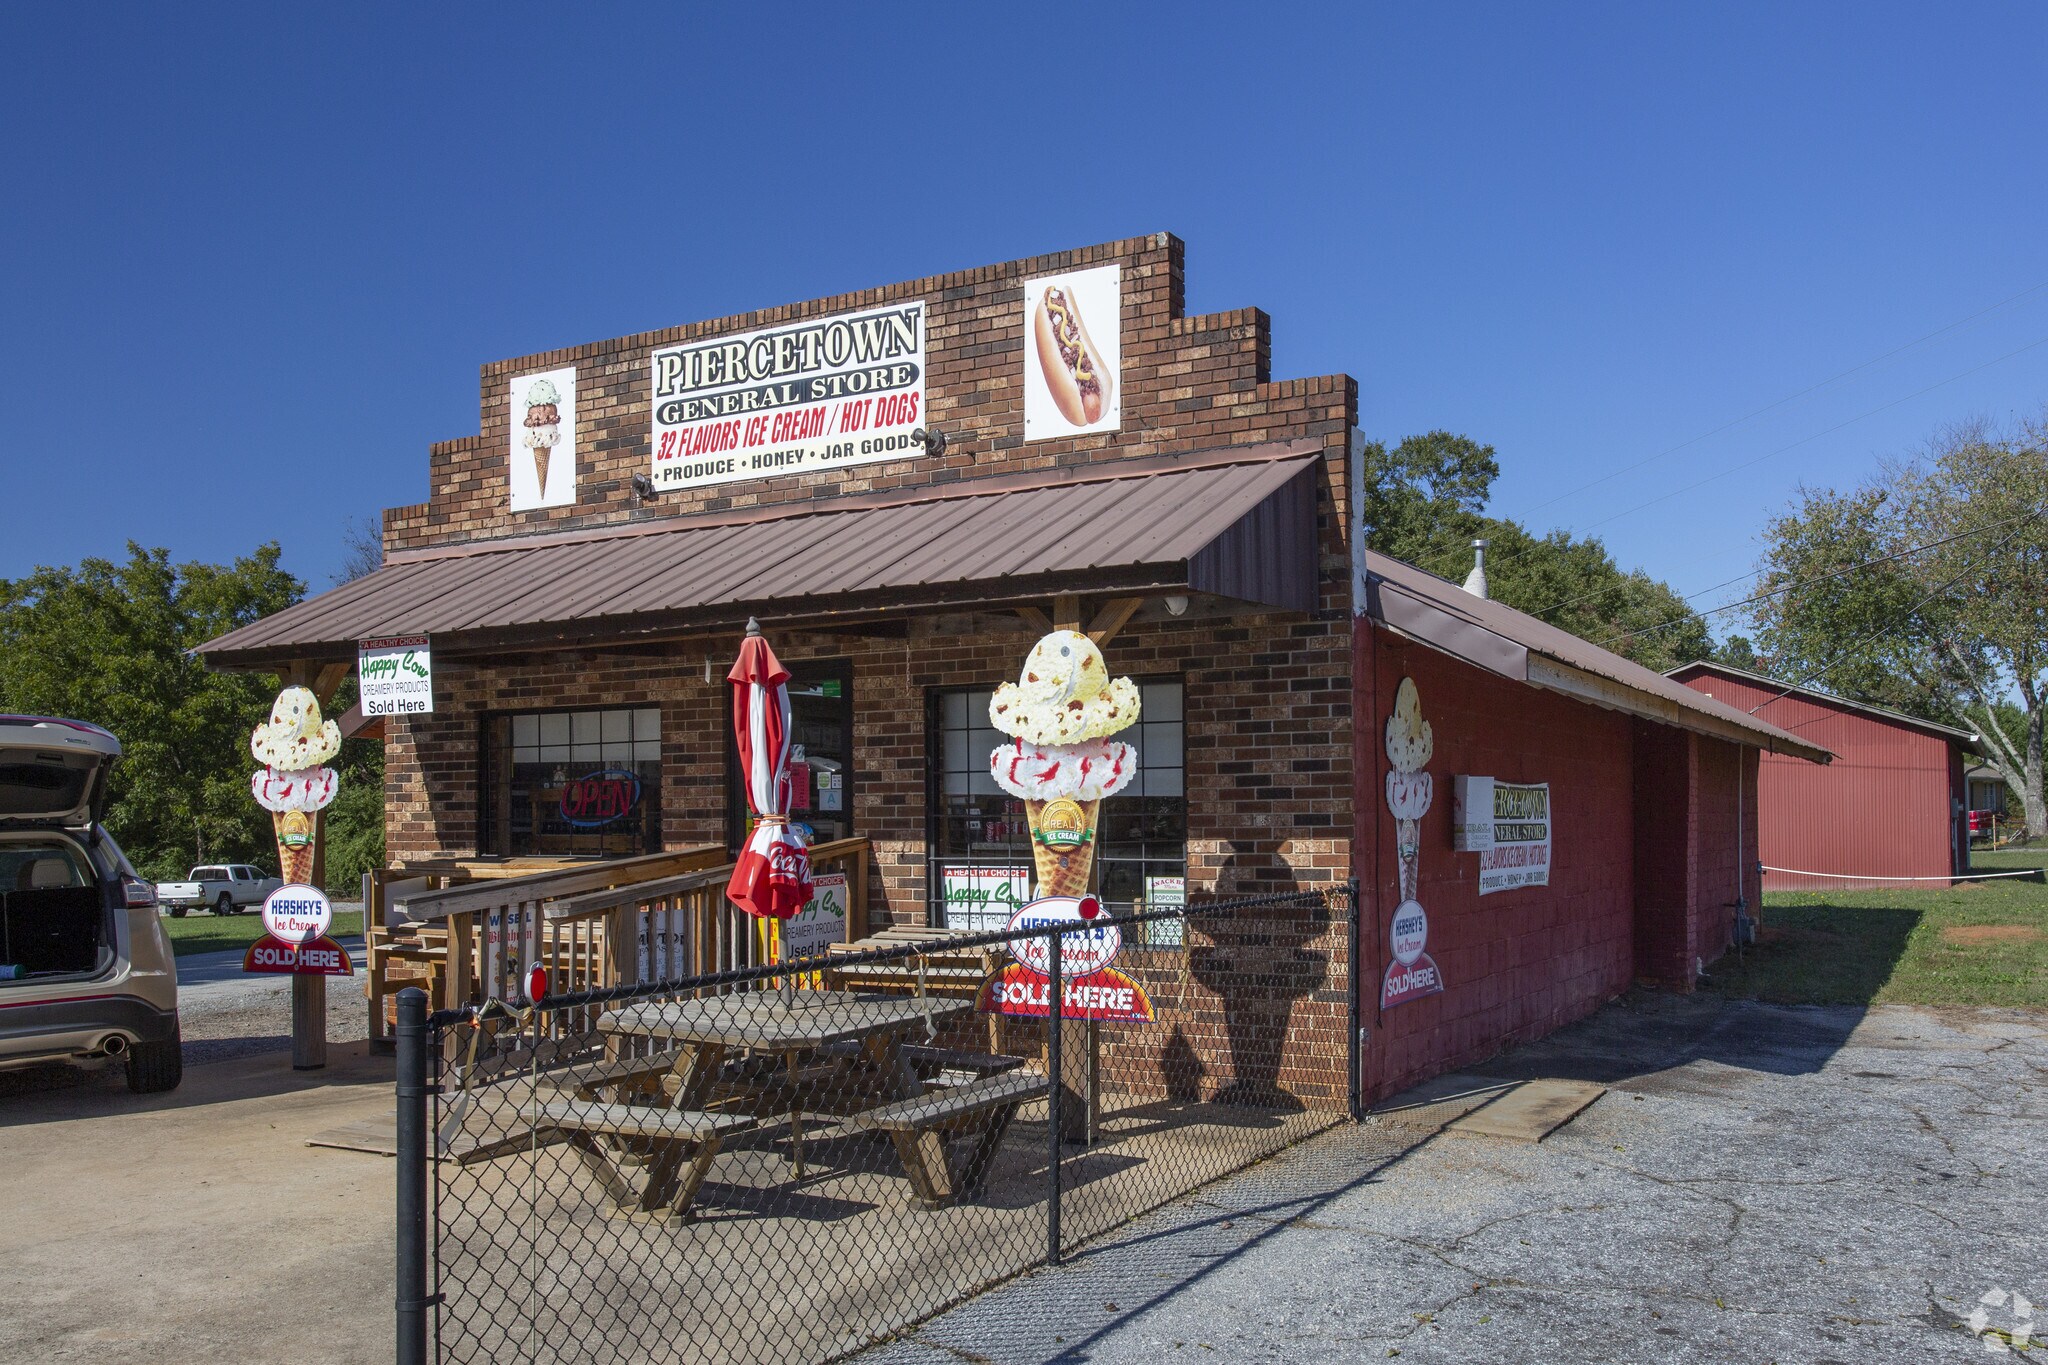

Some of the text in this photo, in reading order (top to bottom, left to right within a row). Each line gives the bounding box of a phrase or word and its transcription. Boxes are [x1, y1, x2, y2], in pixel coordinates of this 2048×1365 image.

[656, 306, 922, 397] PIERCETOWN
[661, 364, 912, 423] GENERAL STORE
[657, 431, 677, 461] 32
[680, 419, 740, 457] FLAVORS
[742, 415, 769, 448] ICE
[771, 406, 827, 445] CREAM
[840, 398, 872, 432] HOT
[873, 391, 919, 428] DOGS
[664, 434, 920, 482] PRODUCE HONEY JAR GOODS
[369, 639, 399, 648] HEALTHY
[361, 649, 429, 680] Happy Cow
[363, 680, 429, 696] CREAMERY PRODUCTS
[368, 698, 425, 714] Sold Here
[561, 780, 633, 816] OPEN
[1493, 787, 1547, 820] ERCETOWN
[1050, 819, 1075, 829] REAL
[1494, 824, 1523, 841] NERAL
[1523, 824, 1546, 840] STORE
[1046, 832, 1080, 841] ICE CREAM
[954, 869, 989, 877] HEALTHY
[1482, 875, 1504, 889] PRODUCE
[1176, 879, 1185, 887] BA
[943, 878, 991, 910] Happy
[271, 899, 322, 915] HERSHEY'S
[822, 890, 844, 918] Cow
[274, 916, 320, 932] Ice Cream
[507, 912, 532, 924] SEL
[986, 913, 1010, 925] PROD
[1395, 915, 1423, 937] HERSHEY'S
[787, 920, 845, 938] REAMERY PRODUCTS
[1025, 940, 1101, 962] Ice ream
[1404, 938, 1421, 953] Cream
[254, 948, 340, 968] SOLD HERE
[1387, 966, 1435, 998] SOLD HERE
[1064, 984, 1134, 1011] HERE
